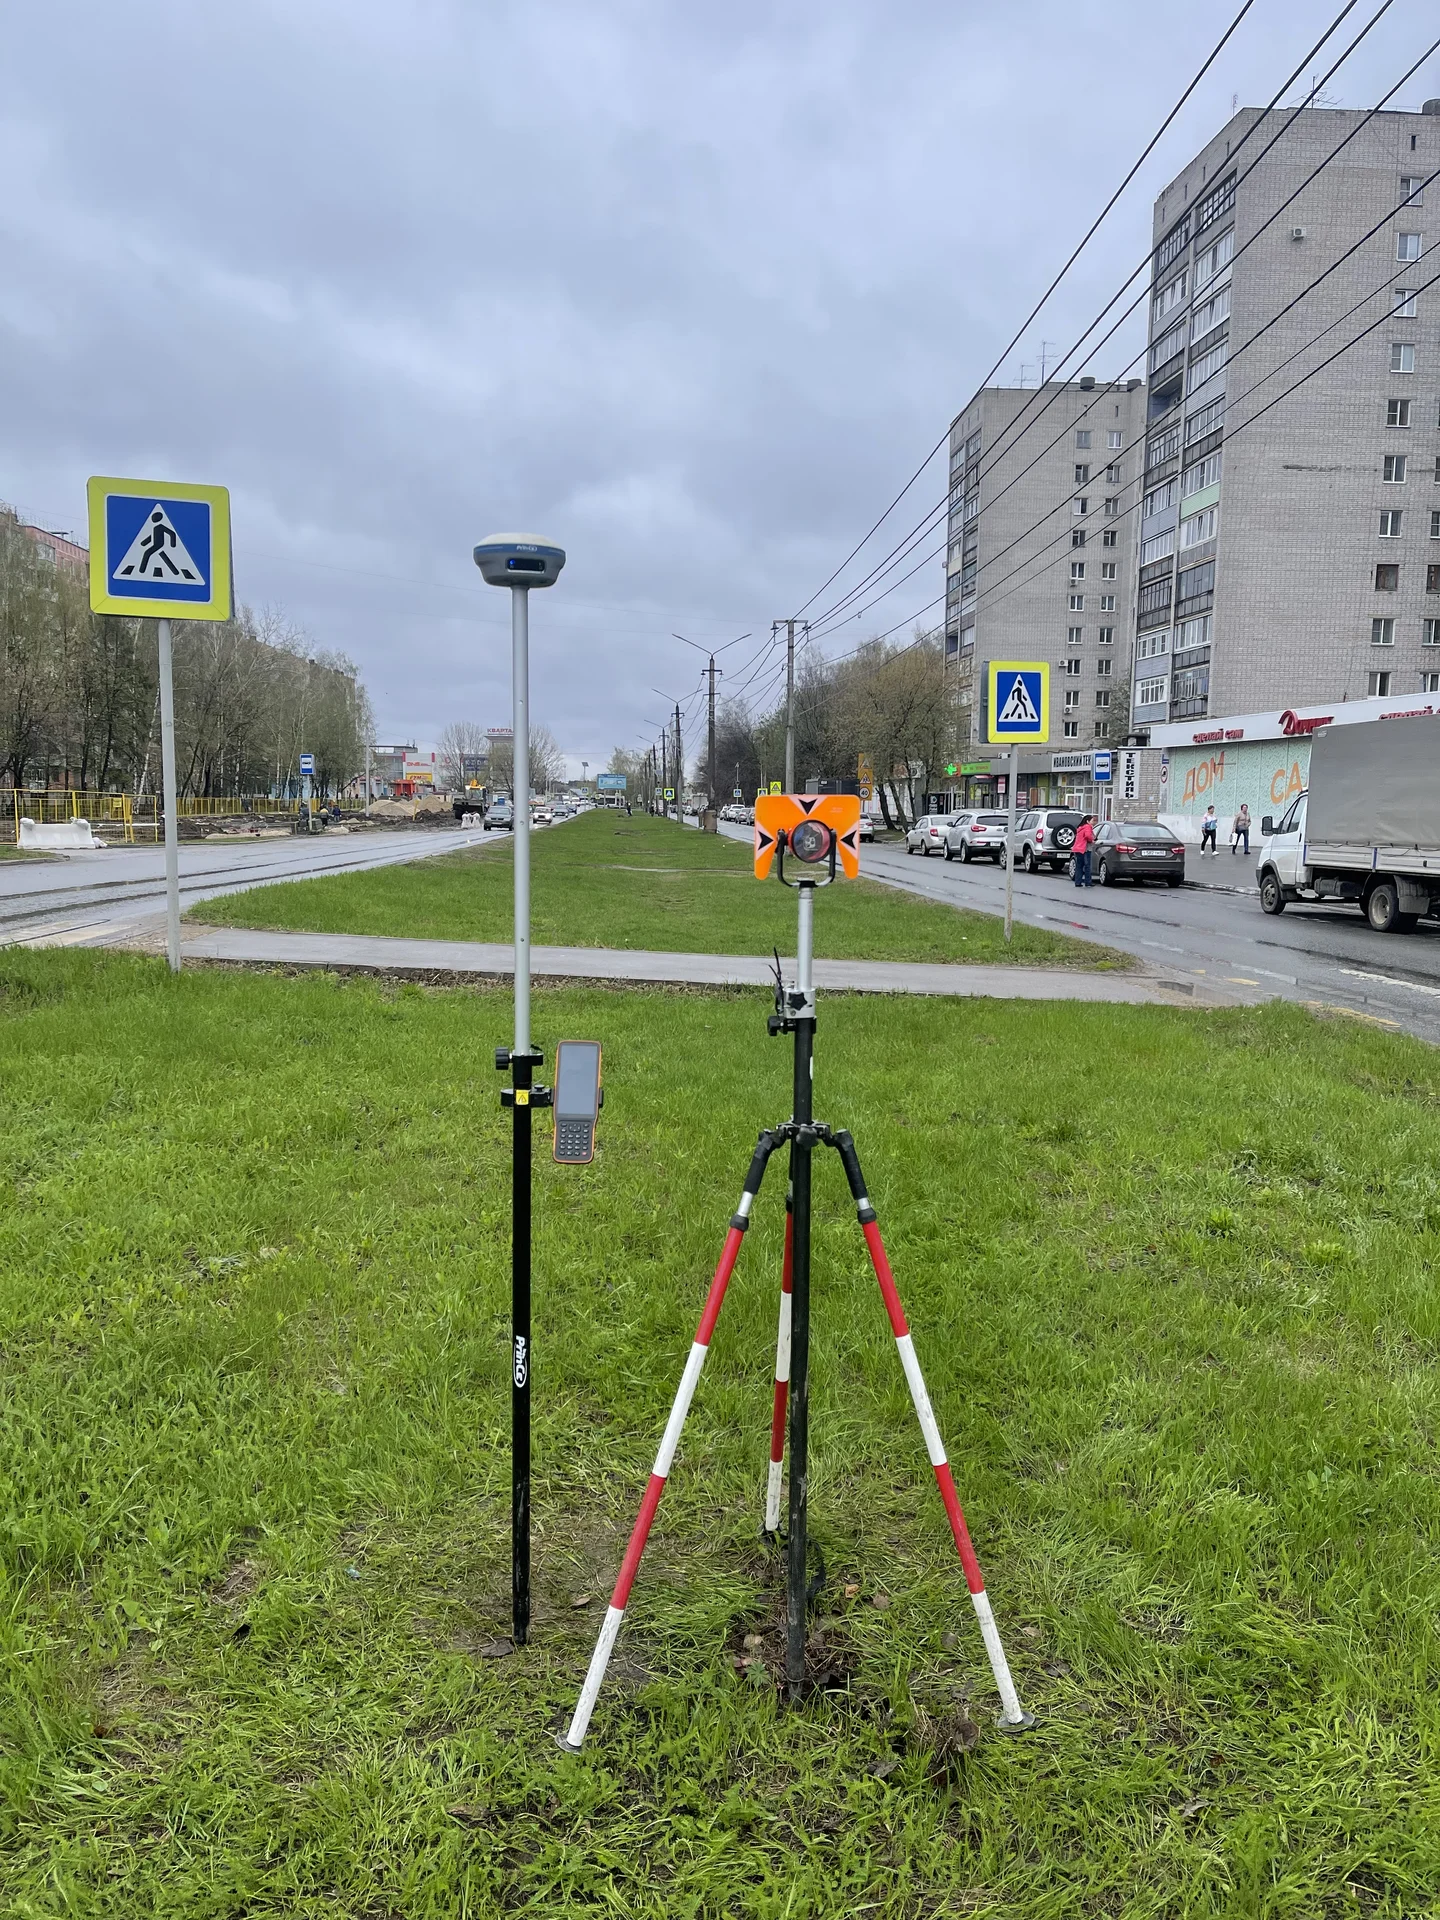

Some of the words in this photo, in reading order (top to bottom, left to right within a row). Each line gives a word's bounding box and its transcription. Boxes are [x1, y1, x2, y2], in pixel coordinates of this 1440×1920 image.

[1225, 729, 1244, 740] сам
[1053, 753, 1082, 767] ИВАНОВСКИЙ
[1125, 752, 1136, 799] ТЕКСТИЛЬ
[1182, 751, 1225, 807] ДОМ
[1271, 761, 1309, 804] СА
